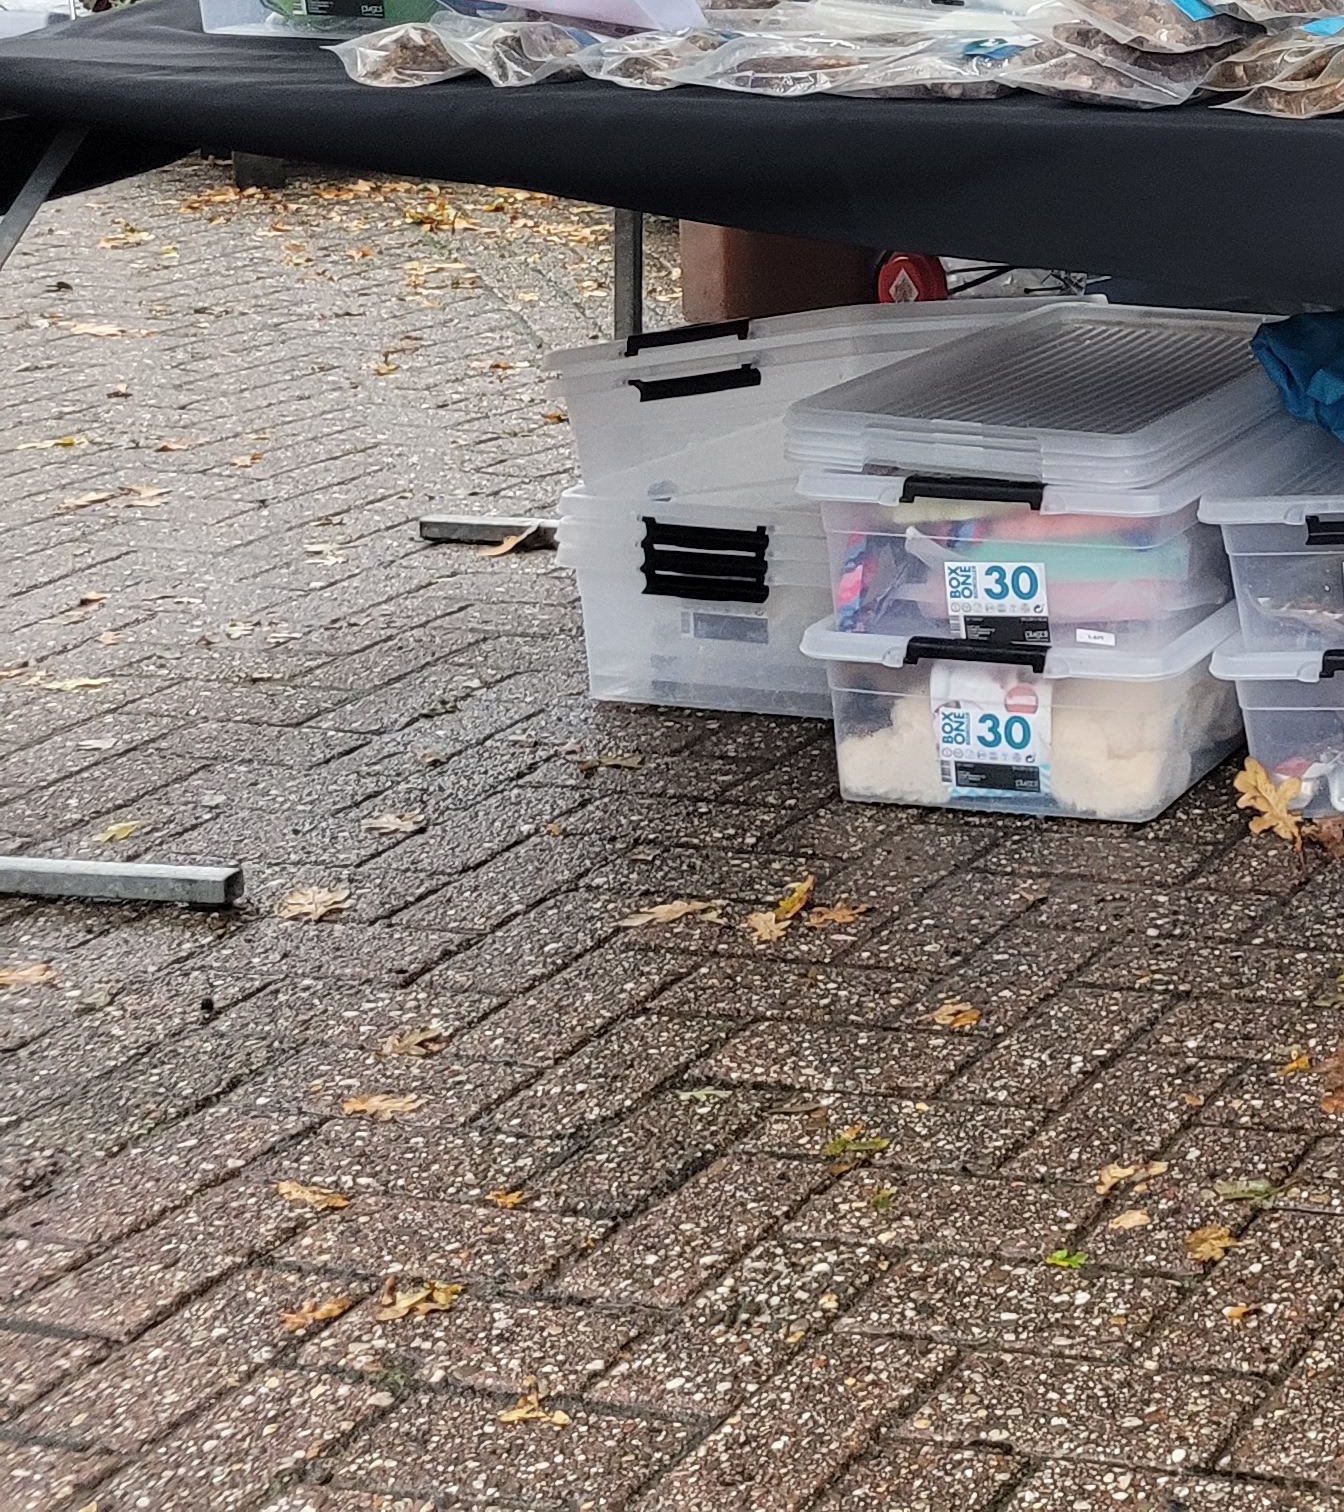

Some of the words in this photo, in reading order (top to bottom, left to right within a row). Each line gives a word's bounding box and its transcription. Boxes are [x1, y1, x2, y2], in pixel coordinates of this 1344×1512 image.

[947, 565, 961, 599] BOX
[959, 565, 973, 599] ONE
[984, 565, 1039, 601] 30
[941, 711, 954, 744] BOX
[953, 711, 966, 746] ONE
[977, 713, 1031, 750] 30
